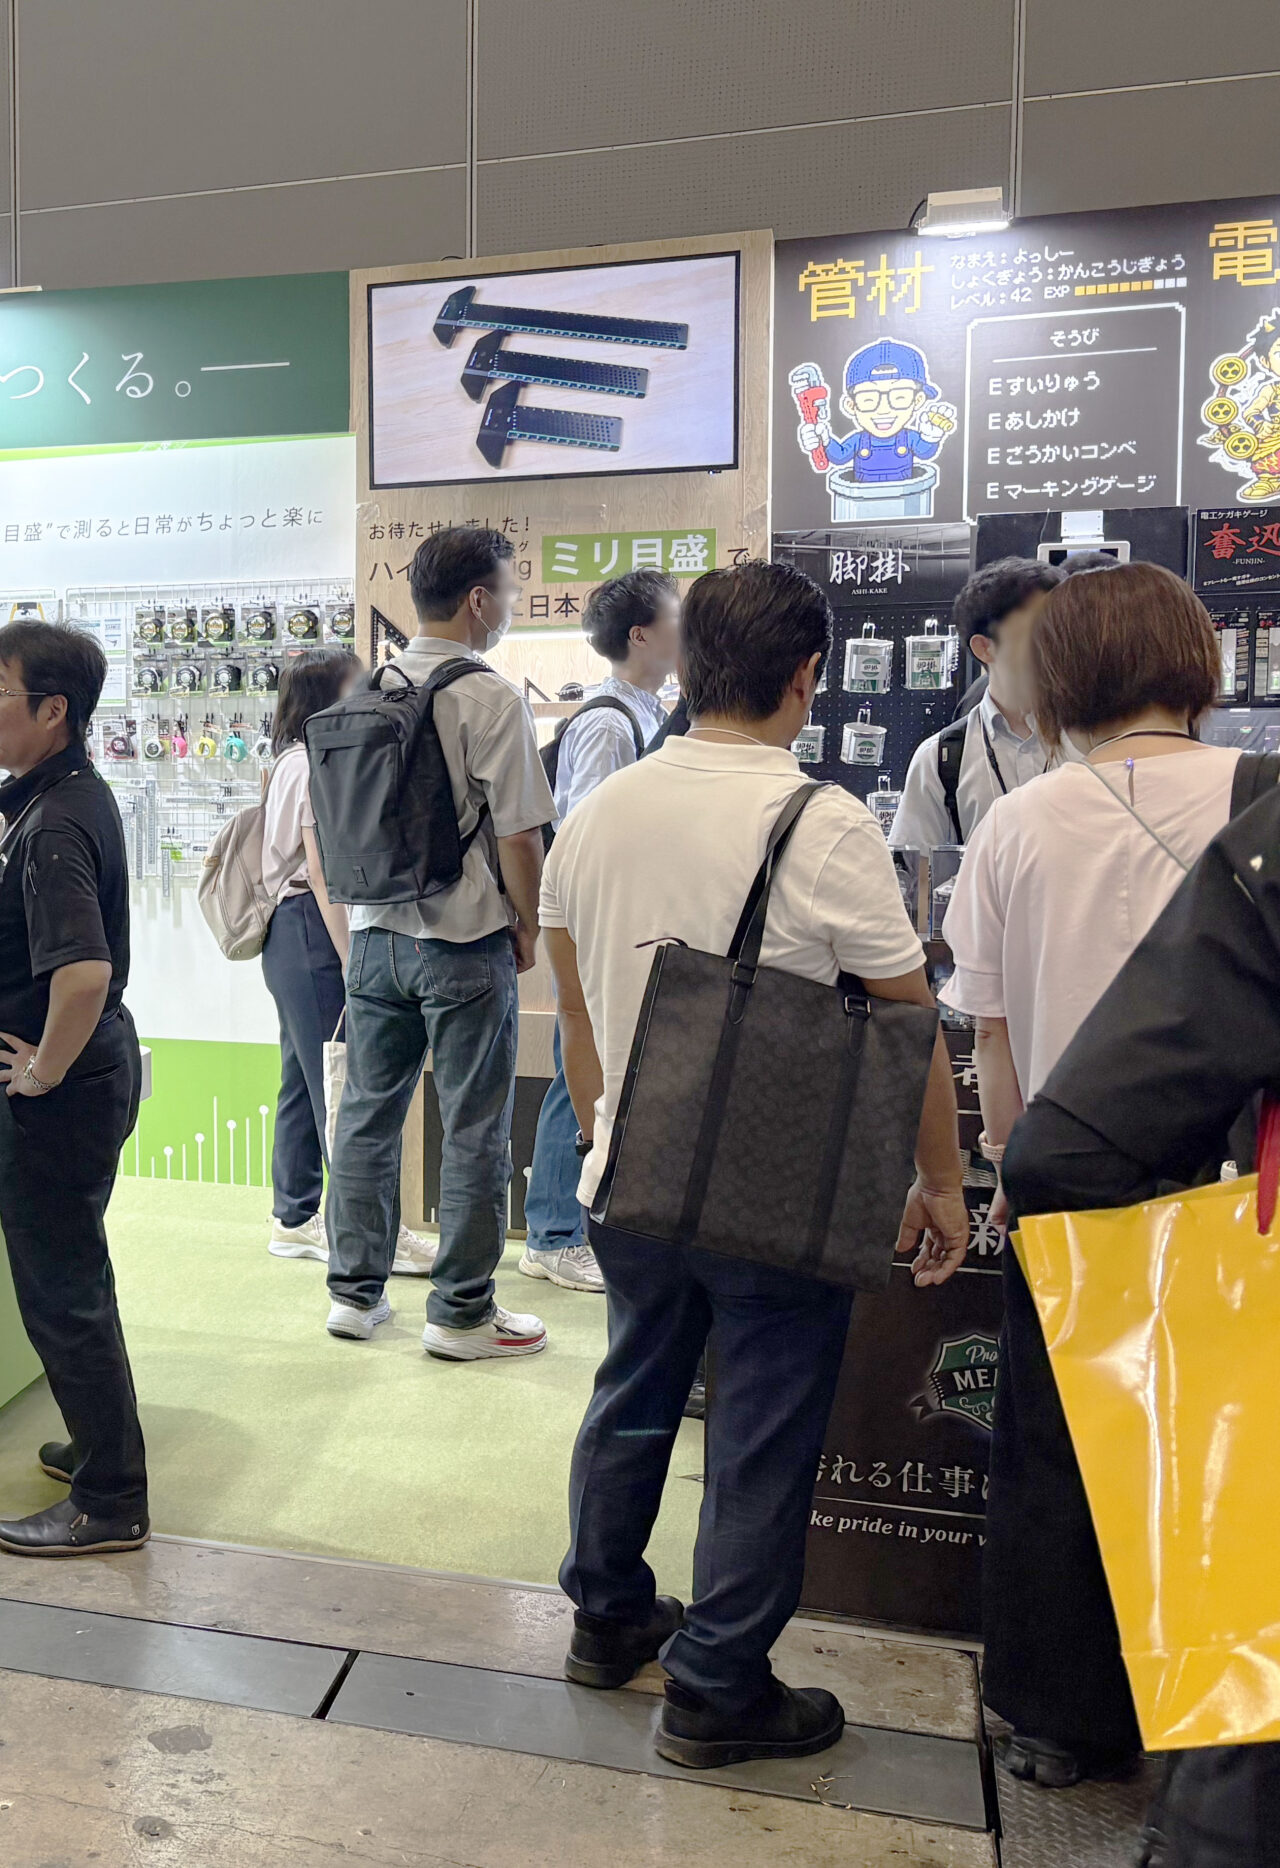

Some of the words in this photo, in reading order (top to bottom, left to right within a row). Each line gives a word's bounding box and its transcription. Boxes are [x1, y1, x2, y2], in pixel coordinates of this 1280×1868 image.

[798, 250, 935, 321] 管材
[1043, 285, 1070, 300] EXP
[1050, 328, 1100, 347] そうび
[1006, 371, 1100, 396] すいりゅう
[1005, 407, 1080, 430] あしかけ
[1004, 475, 1157, 499] マーキングゲージ
[851, 587, 888, 596] ASHI-KAKE
[952, 1368, 998, 1391] ME
[837, 1516, 893, 1535] pride
[898, 1521, 918, 1538] in
[920, 1528, 972, 1544] your
